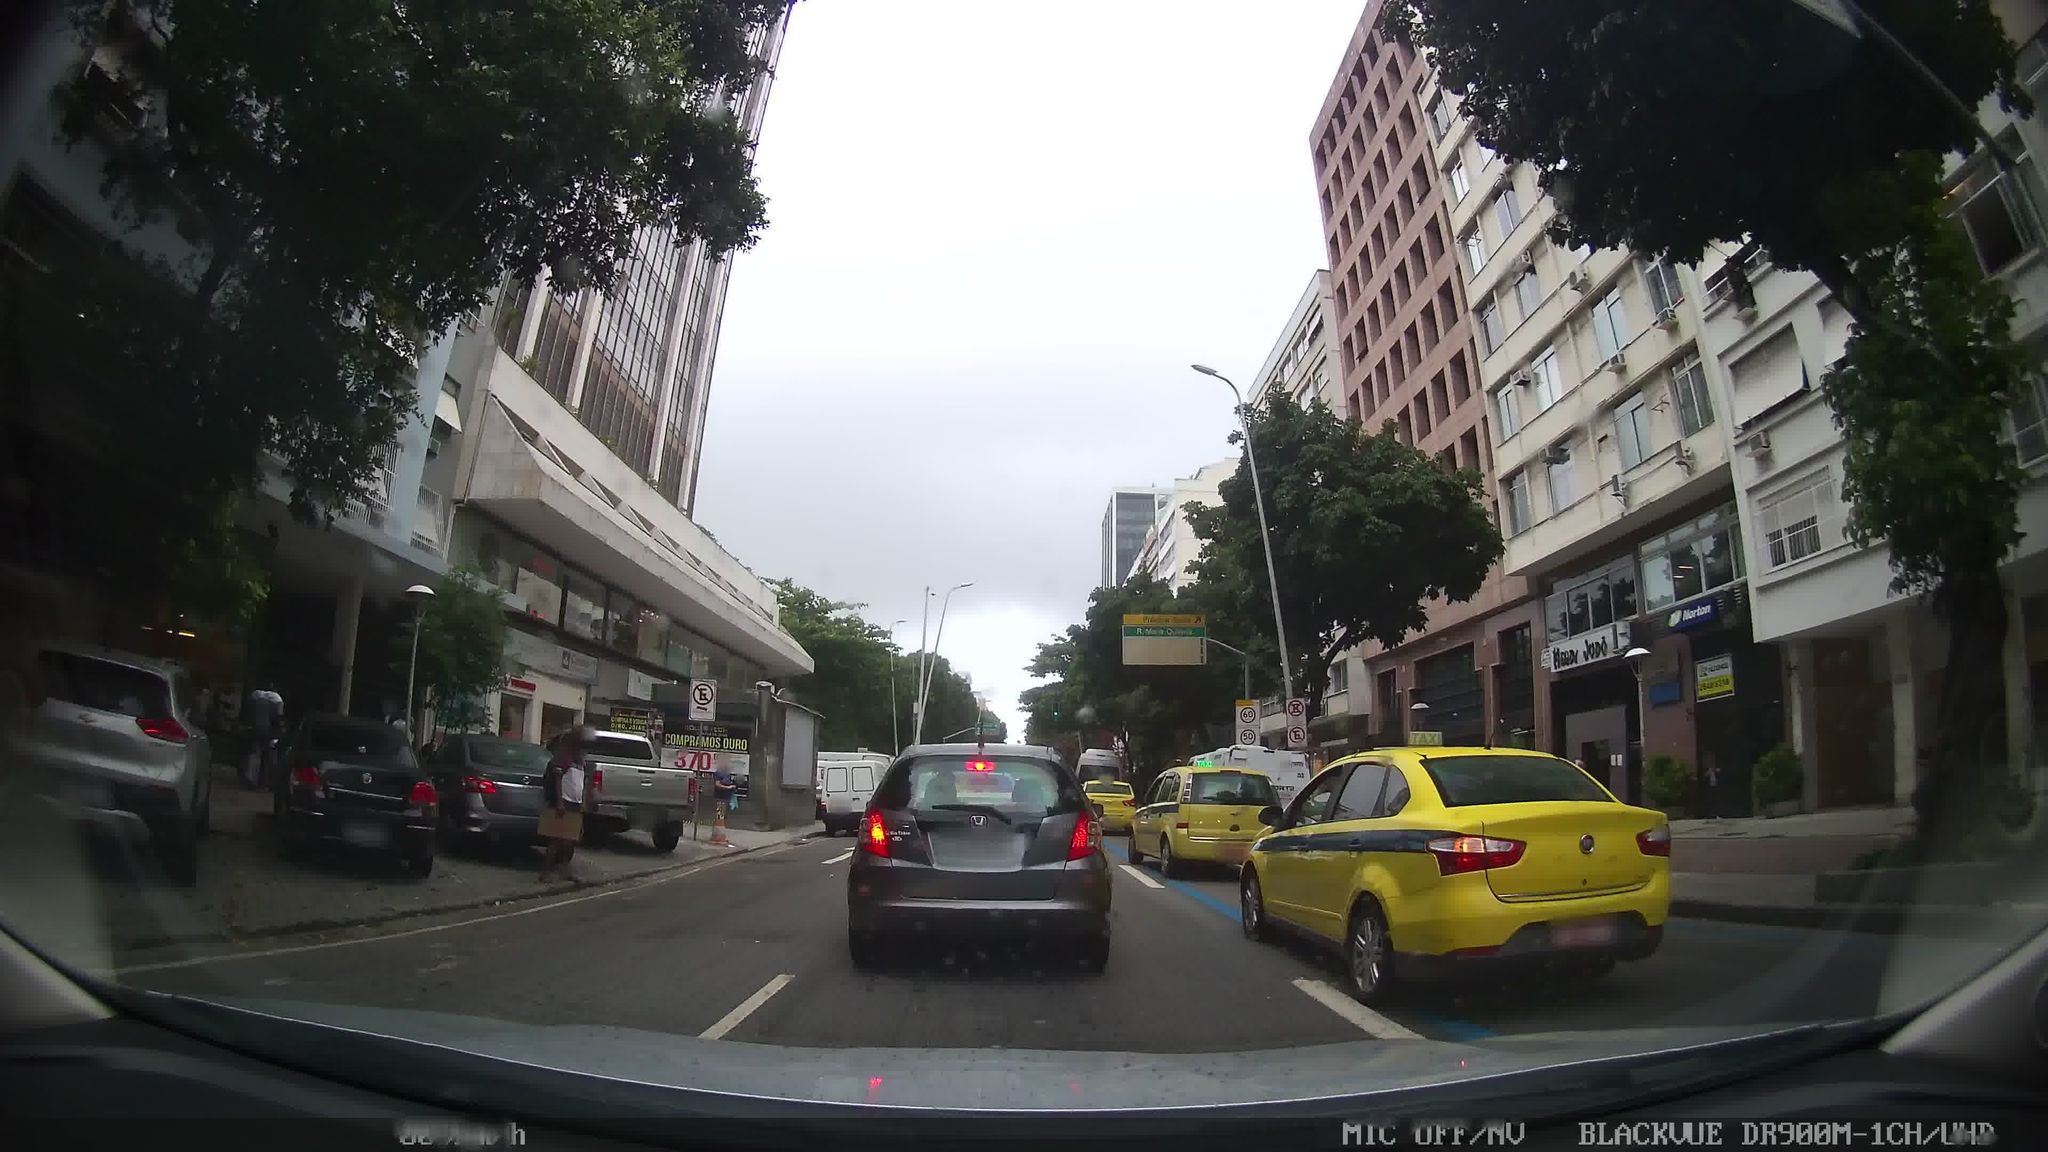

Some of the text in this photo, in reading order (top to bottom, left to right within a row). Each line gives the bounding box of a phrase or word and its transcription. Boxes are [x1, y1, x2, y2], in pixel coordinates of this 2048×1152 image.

[1682, 604, 1712, 621] Norton
[1136, 627, 1144, 635] R.
[1243, 710, 1253, 718] 60
[665, 733, 748, 750] COMPRAMOS OURO
[1243, 732, 1253, 740] 50
[674, 751, 711, 770] 370
